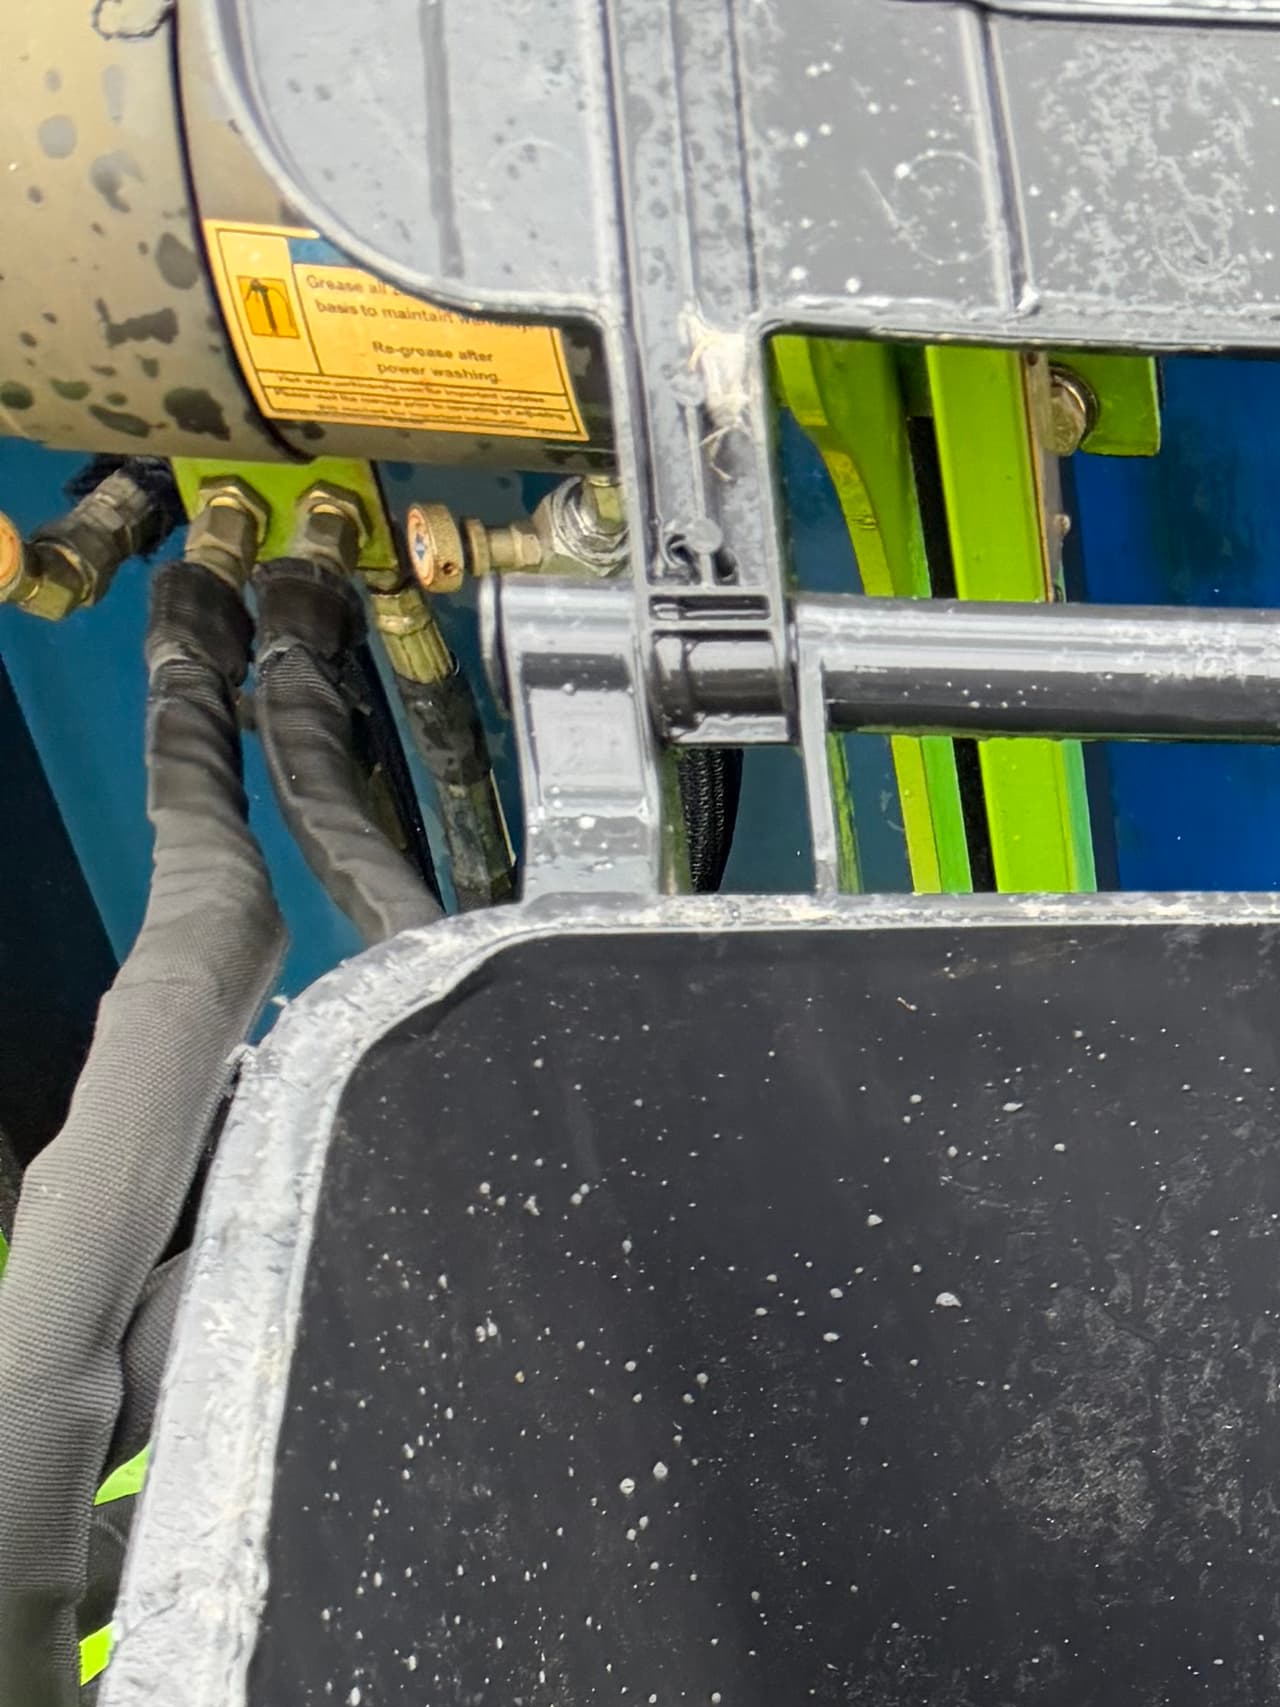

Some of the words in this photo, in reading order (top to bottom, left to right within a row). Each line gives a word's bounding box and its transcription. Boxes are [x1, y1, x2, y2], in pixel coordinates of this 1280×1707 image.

[306, 274, 363, 293] Grease
[369, 282, 387, 295] all
[315, 299, 358, 315] basis
[360, 304, 378, 317] to
[381, 307, 454, 323] maintain
[372, 340, 454, 359] Re-grease
[458, 349, 493, 362] after
[377, 362, 425, 376] power
